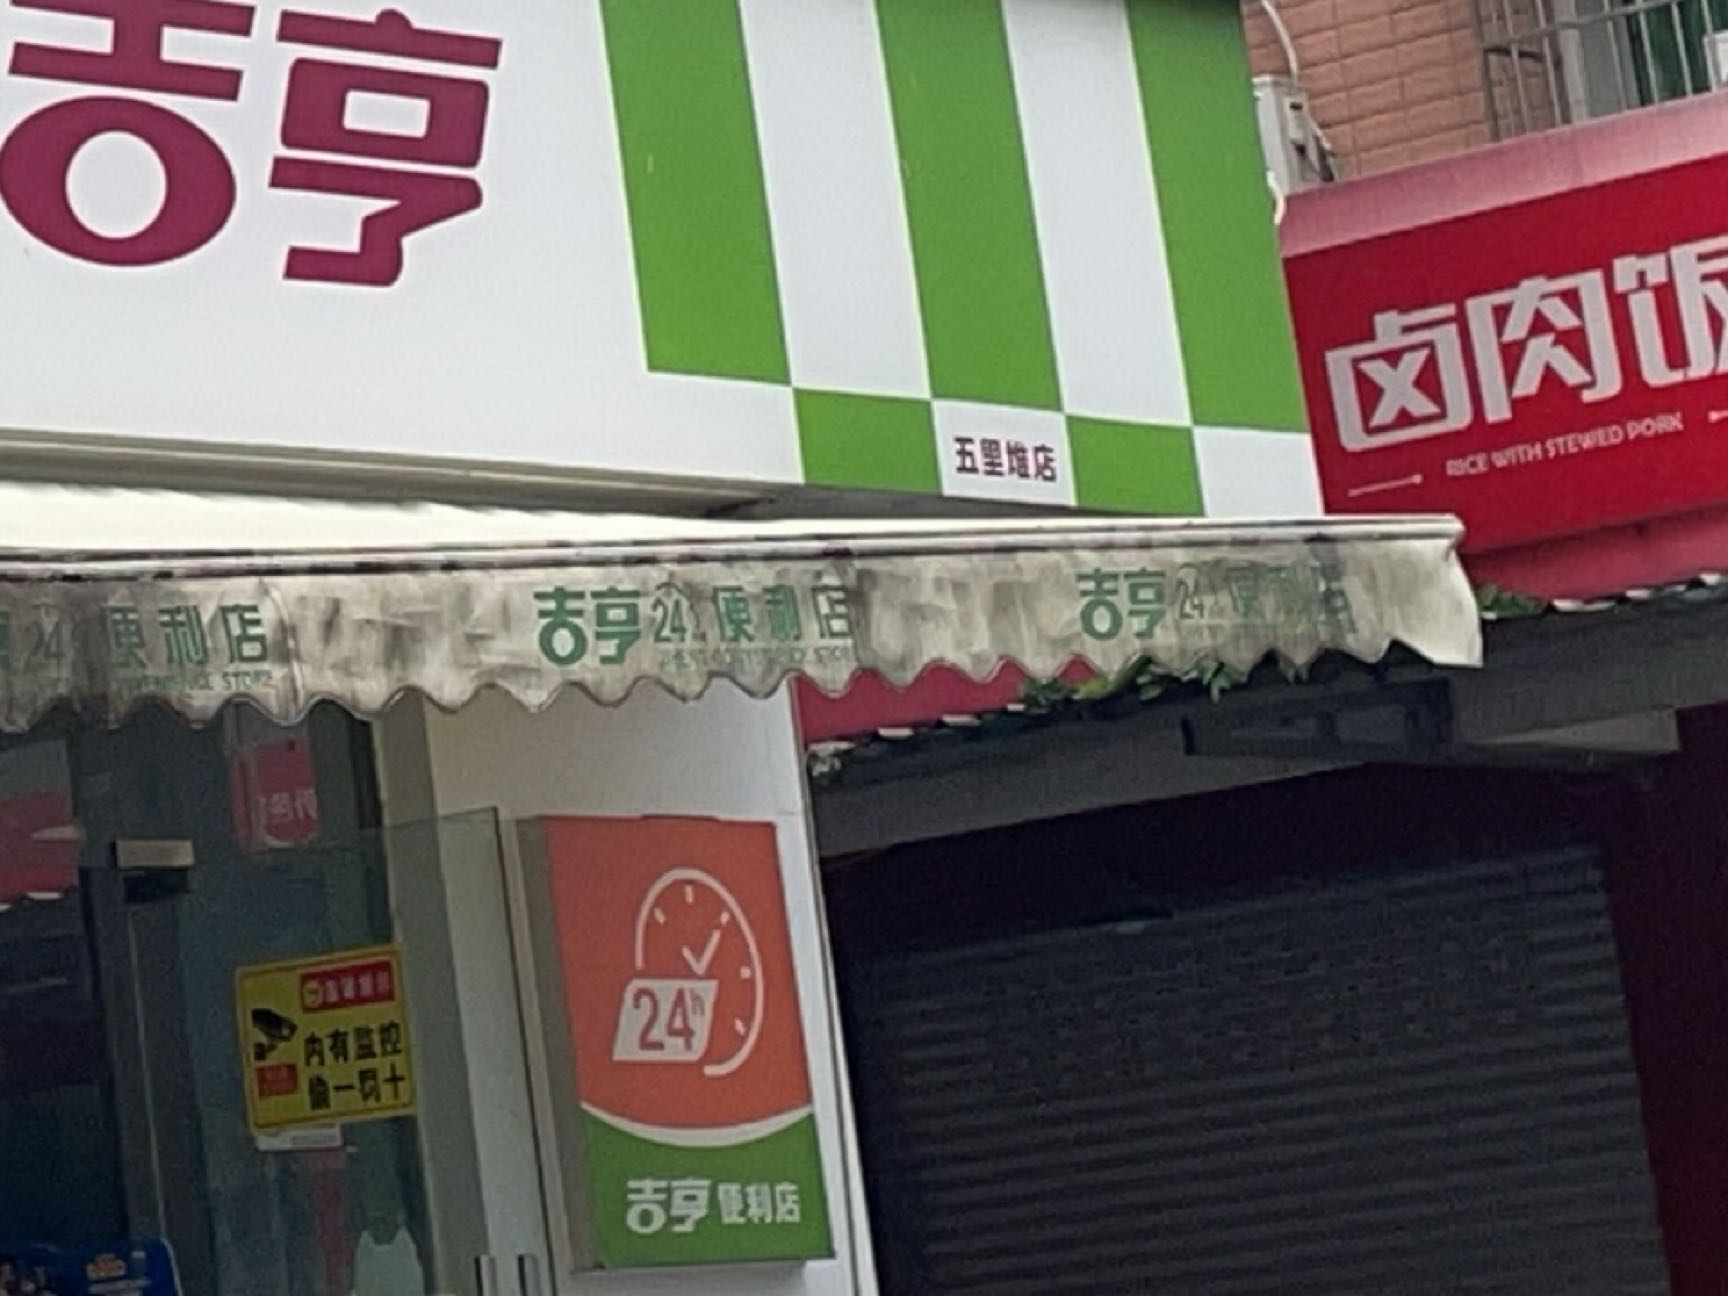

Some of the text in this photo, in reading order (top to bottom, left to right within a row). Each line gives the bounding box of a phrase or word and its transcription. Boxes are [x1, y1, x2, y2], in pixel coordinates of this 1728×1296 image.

[1324, 234, 1728, 452] 卤肉饭
[1446, 411, 1684, 477] RICE WITH STEWED PORK
[303, 1019, 403, 1067] 内有监控
[308, 1061, 406, 1111] 偷一罚十
